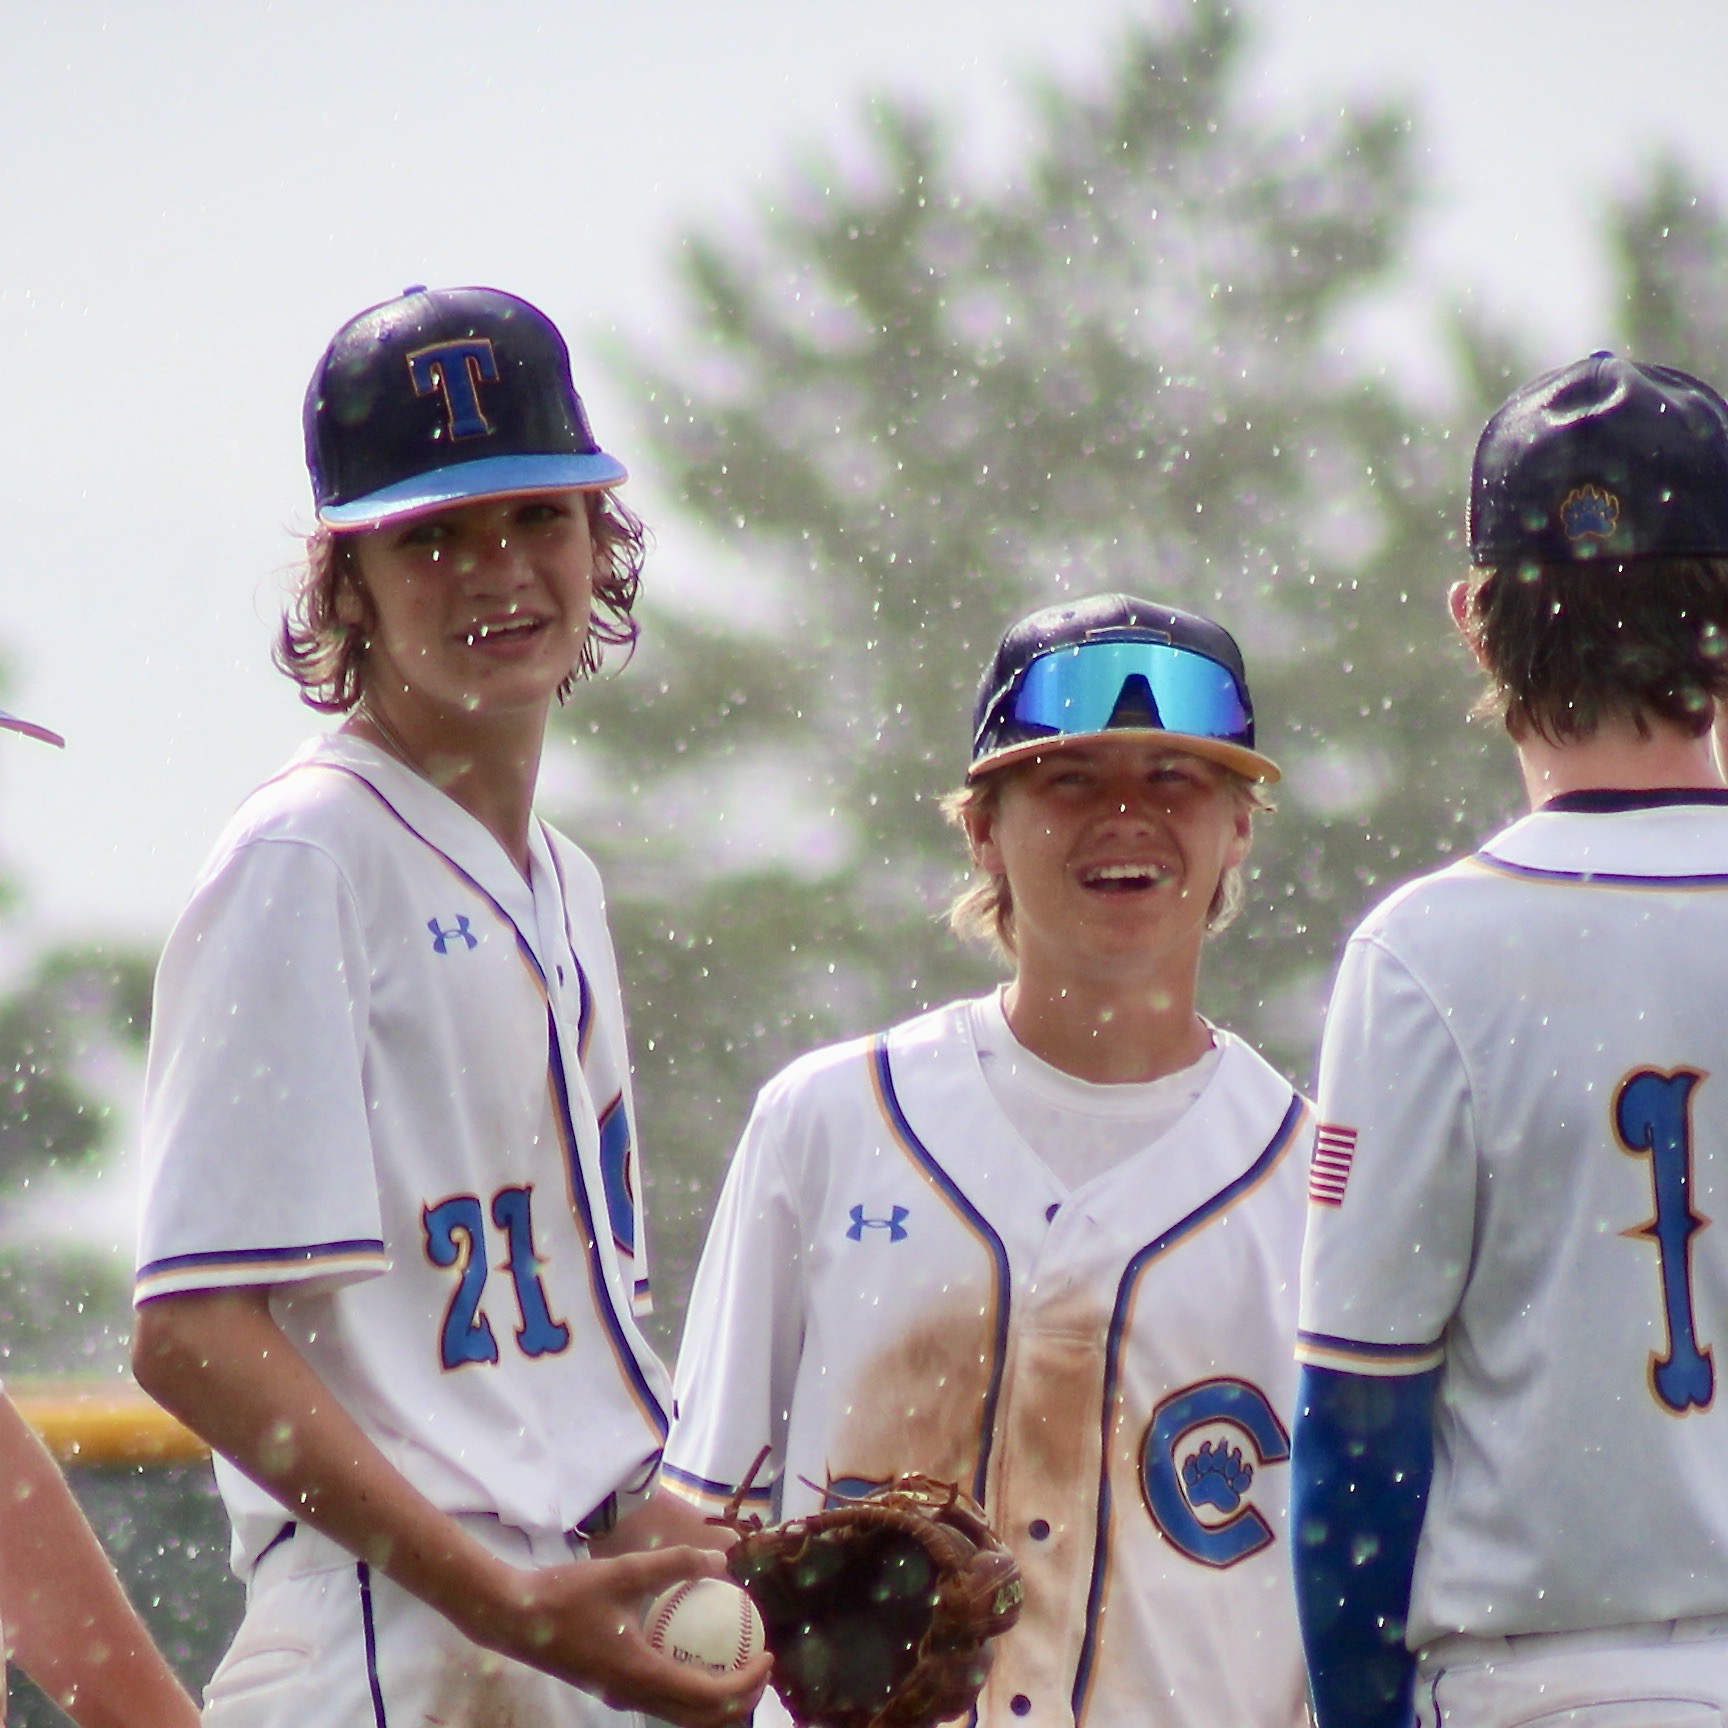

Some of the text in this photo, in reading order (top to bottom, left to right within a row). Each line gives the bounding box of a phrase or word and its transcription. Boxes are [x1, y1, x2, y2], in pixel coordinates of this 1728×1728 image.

[406, 338, 499, 442] T
[419, 1184, 573, 1375] 21
[1138, 1376, 1291, 1569] C
